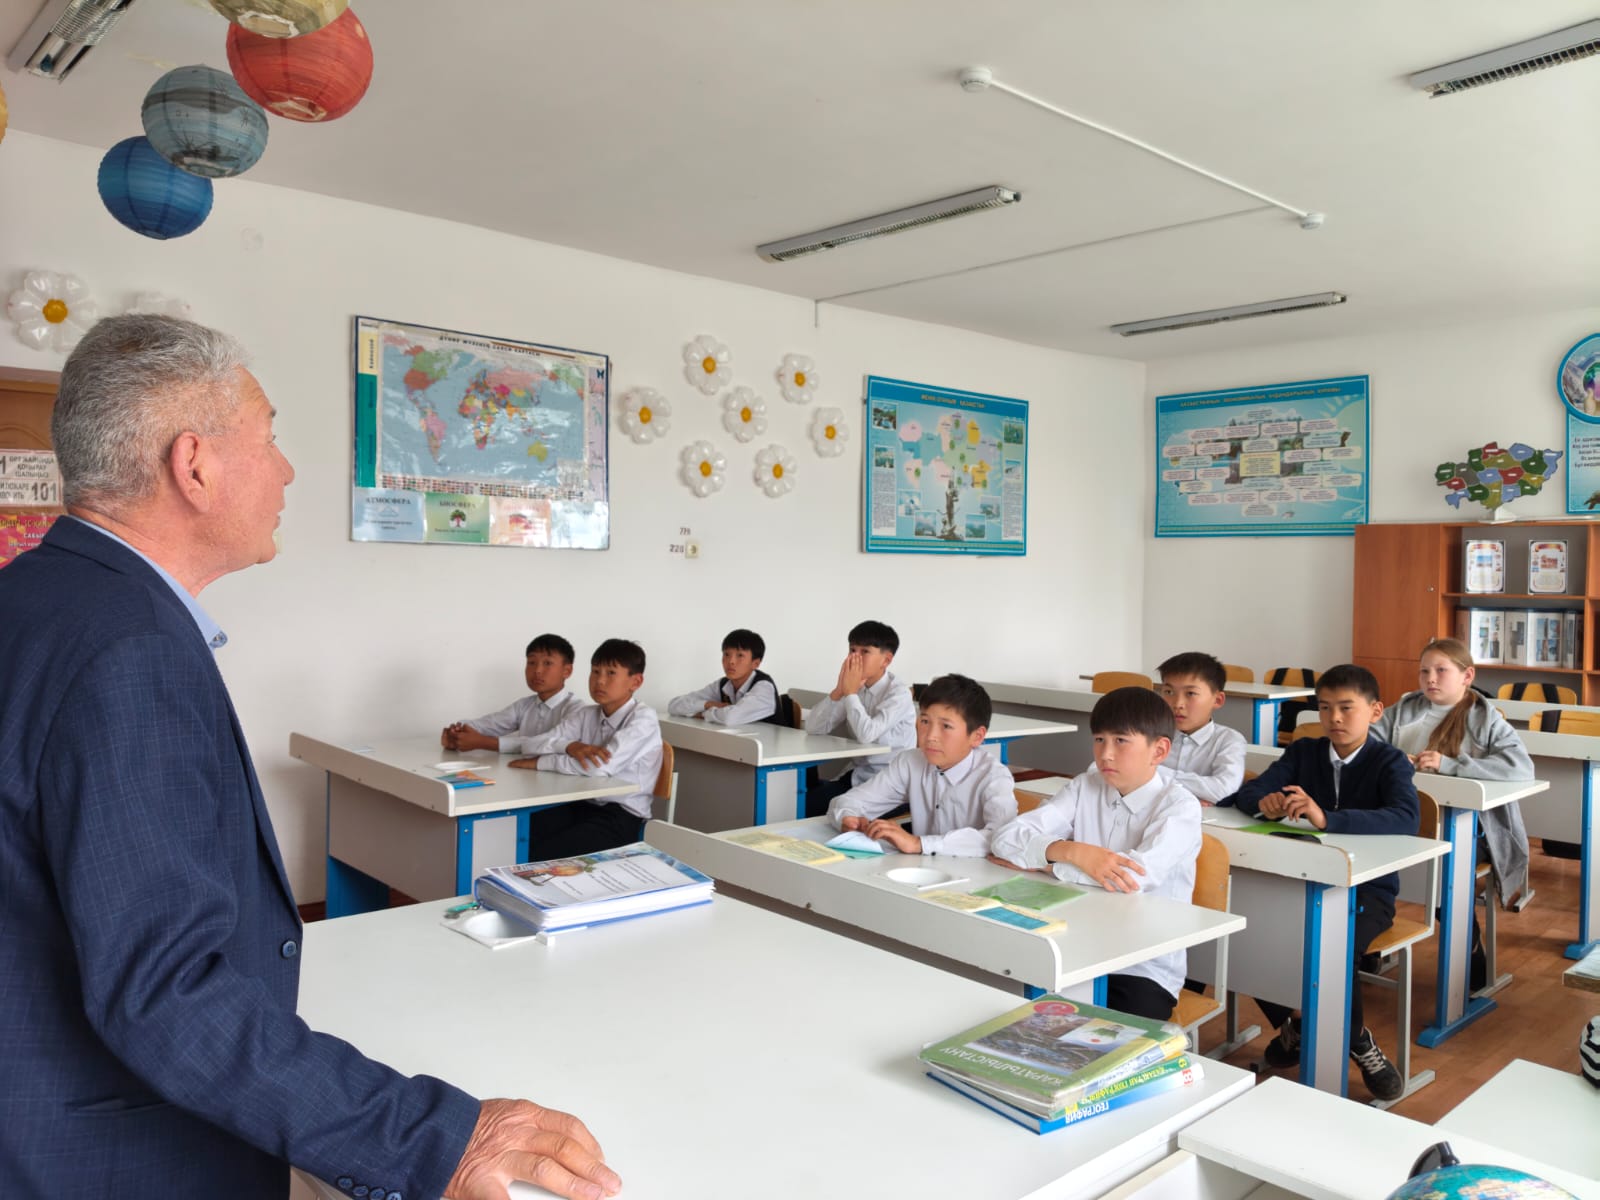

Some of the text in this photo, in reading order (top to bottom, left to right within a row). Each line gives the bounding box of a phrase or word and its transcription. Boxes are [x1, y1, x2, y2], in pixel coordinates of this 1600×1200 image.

[31, 482, 57, 501] 101
[939, 1047, 1064, 1086] ЖАРАТЫЛЫСТАНУ
[1065, 1101, 1109, 1124] ГЕОГРАФИЯ
